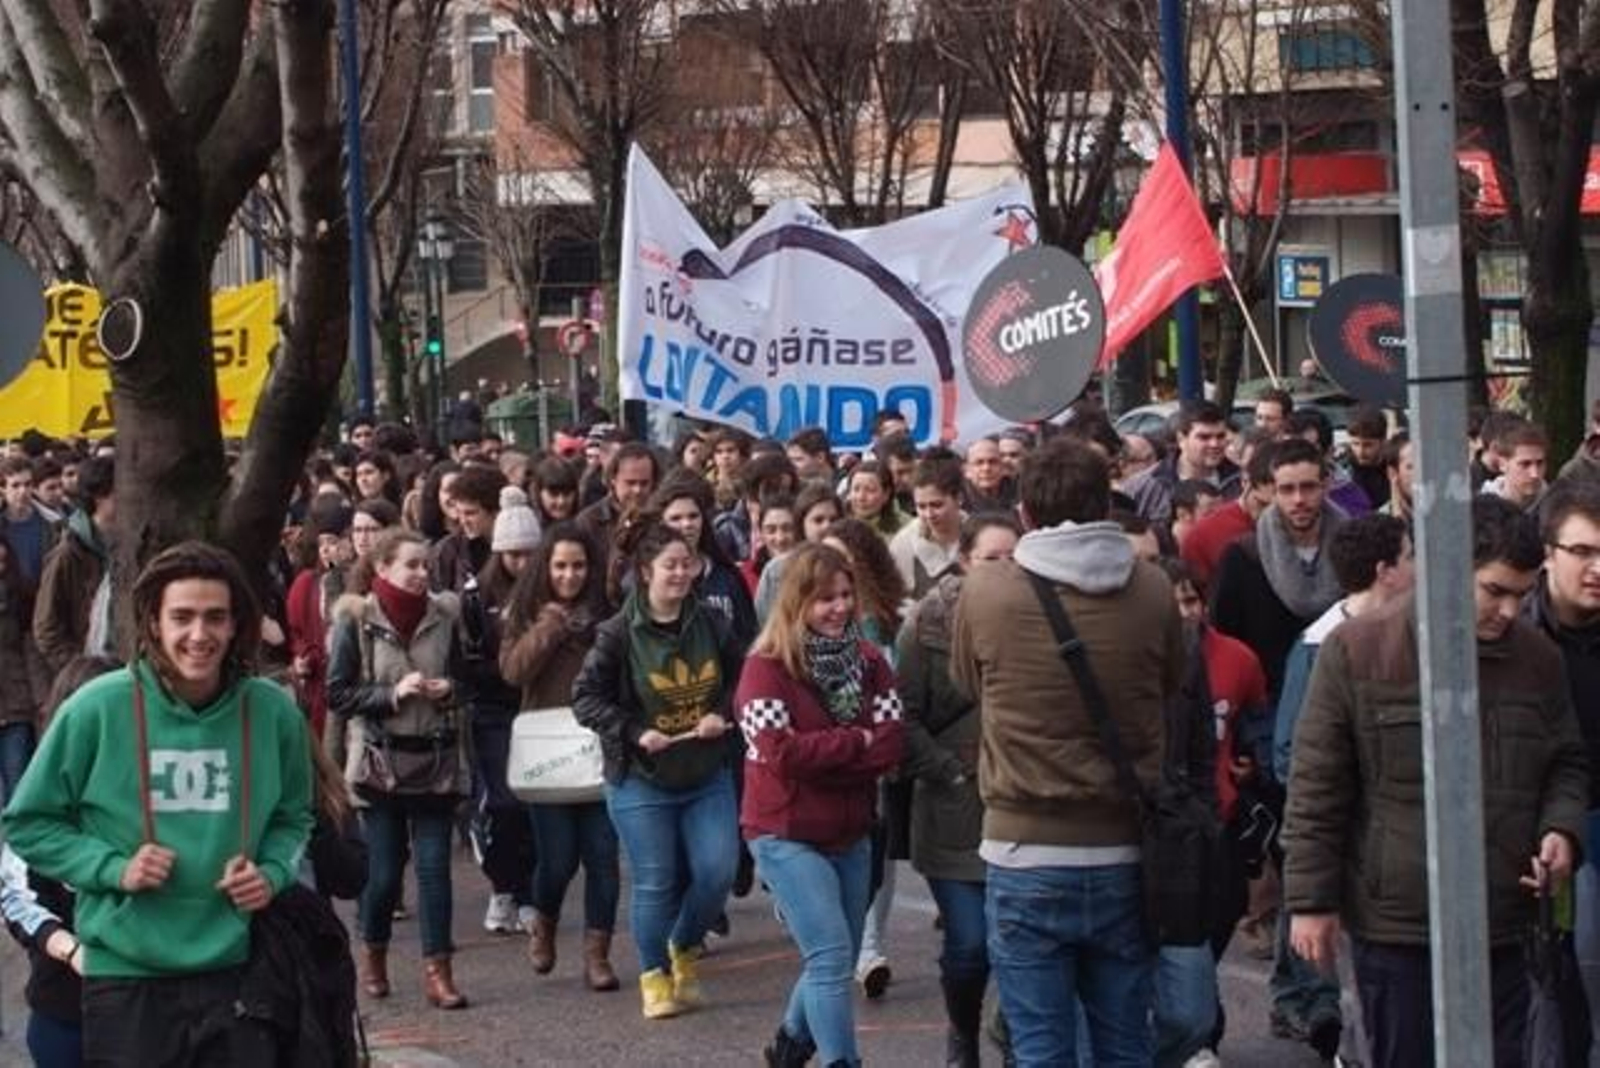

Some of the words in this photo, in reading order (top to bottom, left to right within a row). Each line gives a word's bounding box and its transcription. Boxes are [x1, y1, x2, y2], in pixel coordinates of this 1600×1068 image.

[659, 280, 757, 366] futuro
[766, 327, 917, 378] gáñase
[998, 289, 1091, 353] COMITÉS
